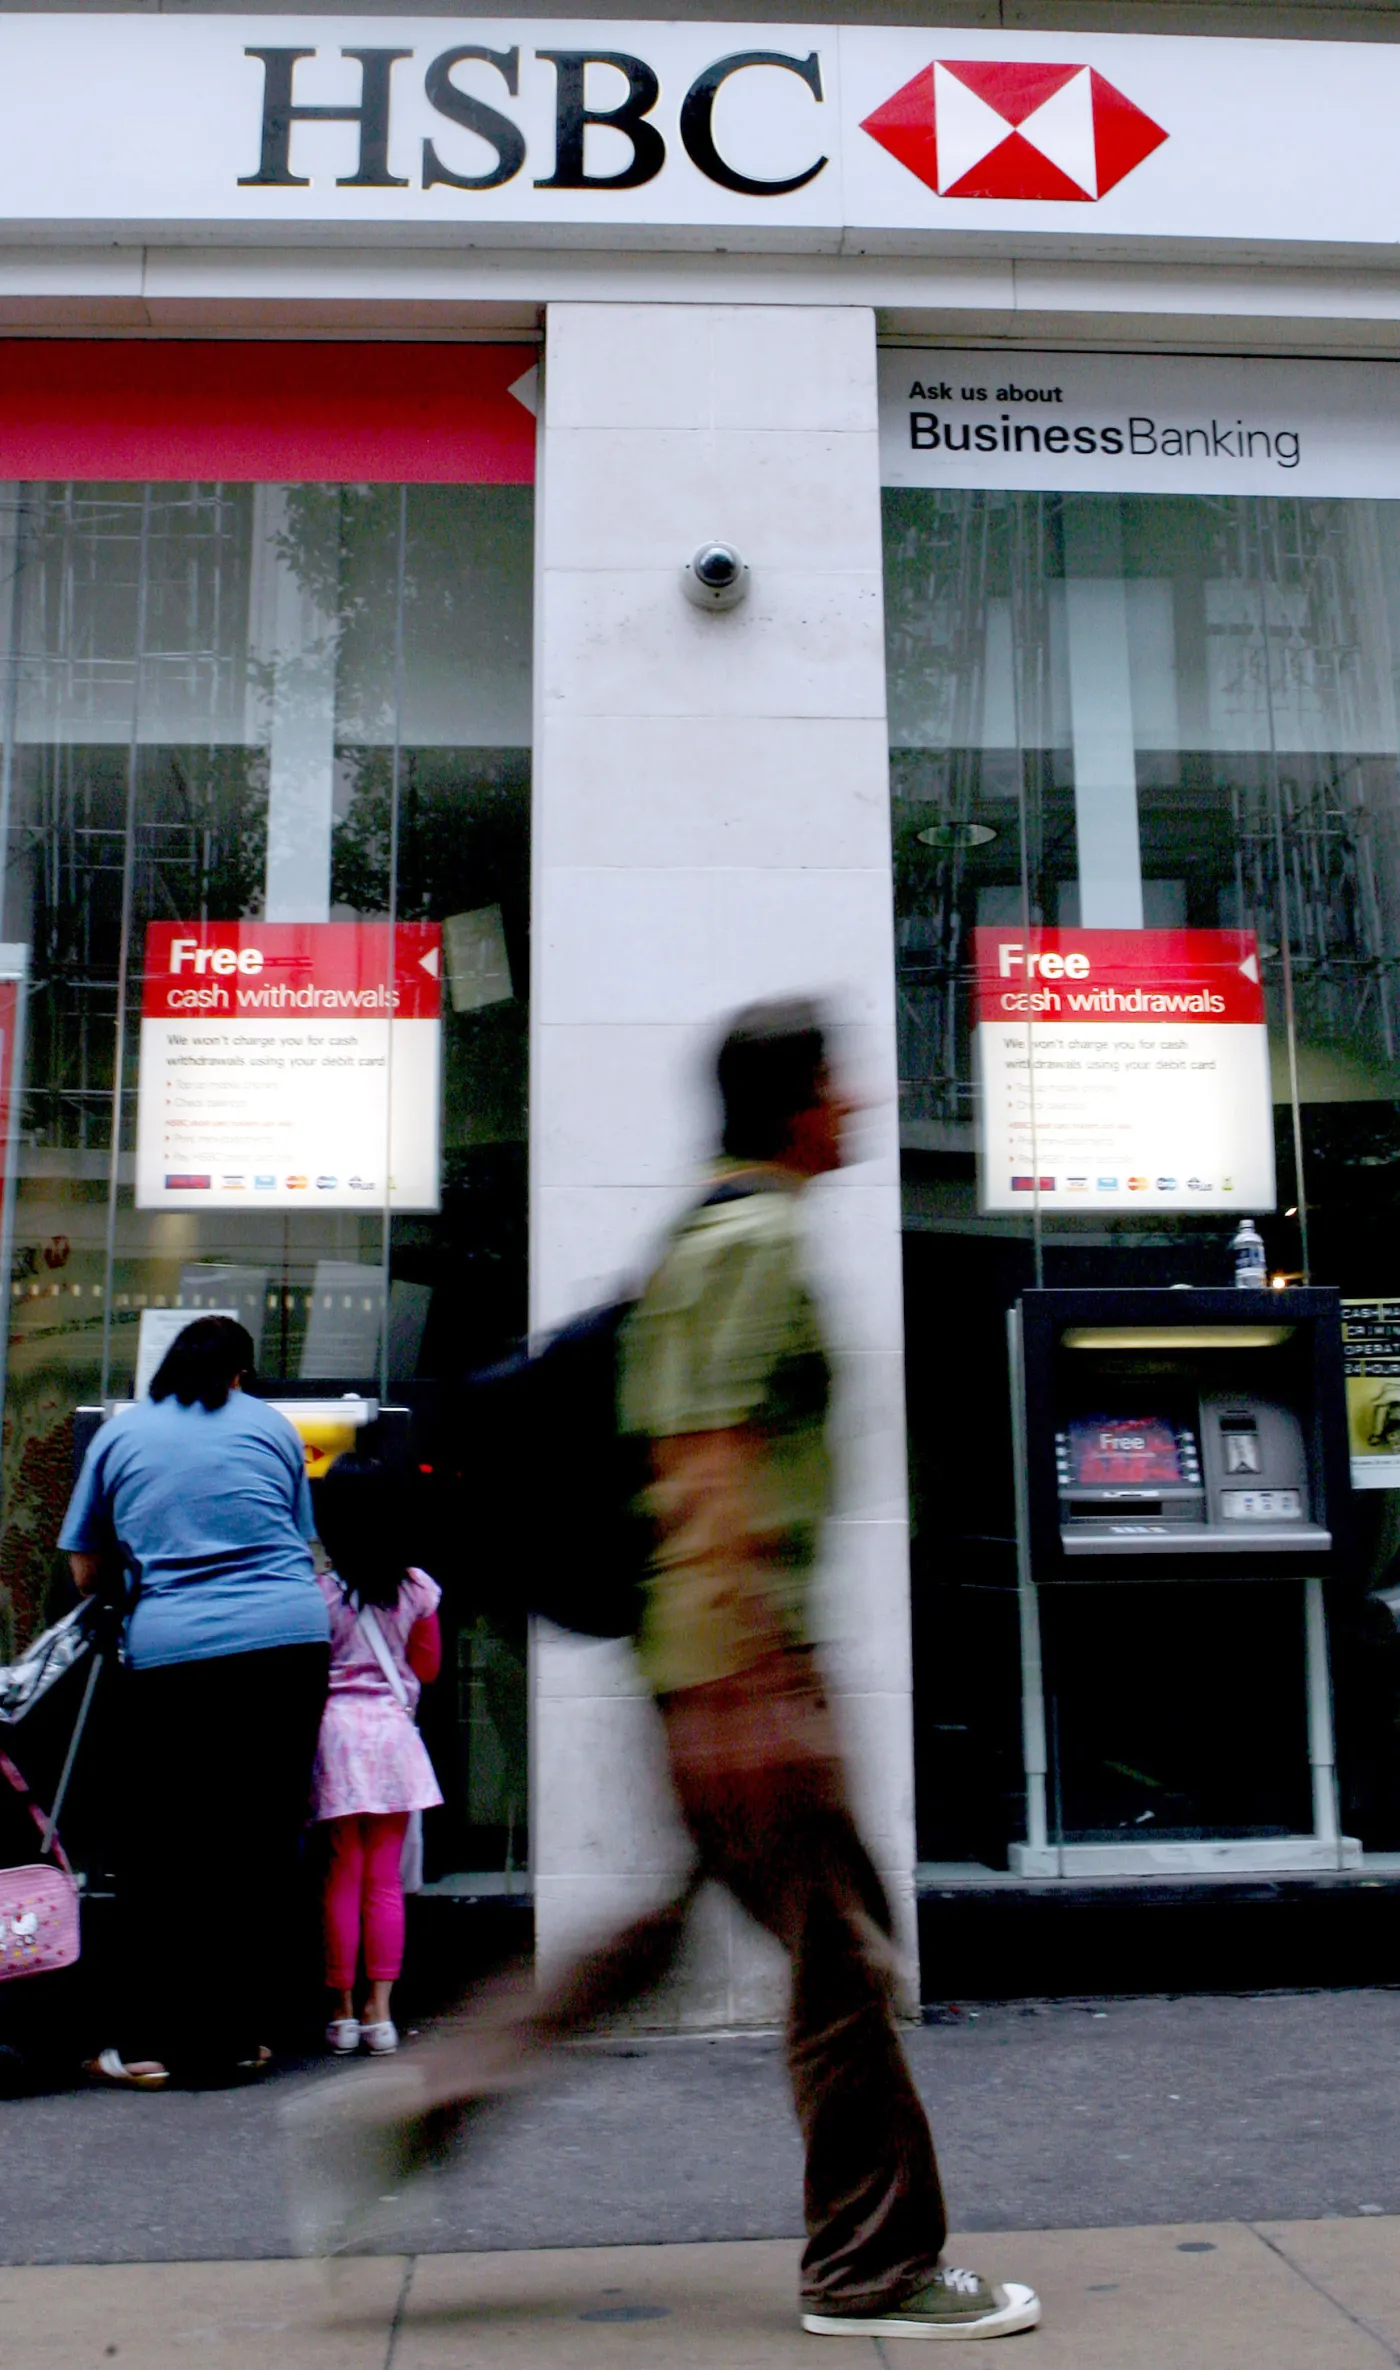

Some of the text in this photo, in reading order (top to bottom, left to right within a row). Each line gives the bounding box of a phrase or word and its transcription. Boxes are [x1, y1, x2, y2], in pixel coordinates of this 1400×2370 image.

[237, 45, 829, 196] HSBC
[909, 381, 1064, 403] Ask us about
[169, 939, 264, 975] Free
[998, 944, 1090, 979] Free
[167, 983, 400, 1008] cash withdrawals
[1000, 987, 1226, 1013] cash withdrawals
[166, 1034, 358, 1048] We won't charge you for cash
[1003, 1038, 1025, 1049] We
[1068, 1038, 1109, 1051] charge
[1113, 1041, 1135, 1051] you
[1139, 1039, 1156, 1050] for
[1160, 1039, 1189, 1050] cash
[166, 1053, 385, 1068] withdrawals using your debit card
[1087, 1060, 1120, 1072] using
[1124, 1061, 1152, 1071] your
[1155, 1059, 1187, 1070] debit
[1190, 1059, 1217, 1070] card
[1340, 1308, 1378, 1319] CASH
[1344, 1342, 1400, 1355] OPERAT
[1099, 1433, 1145, 1450] Free
